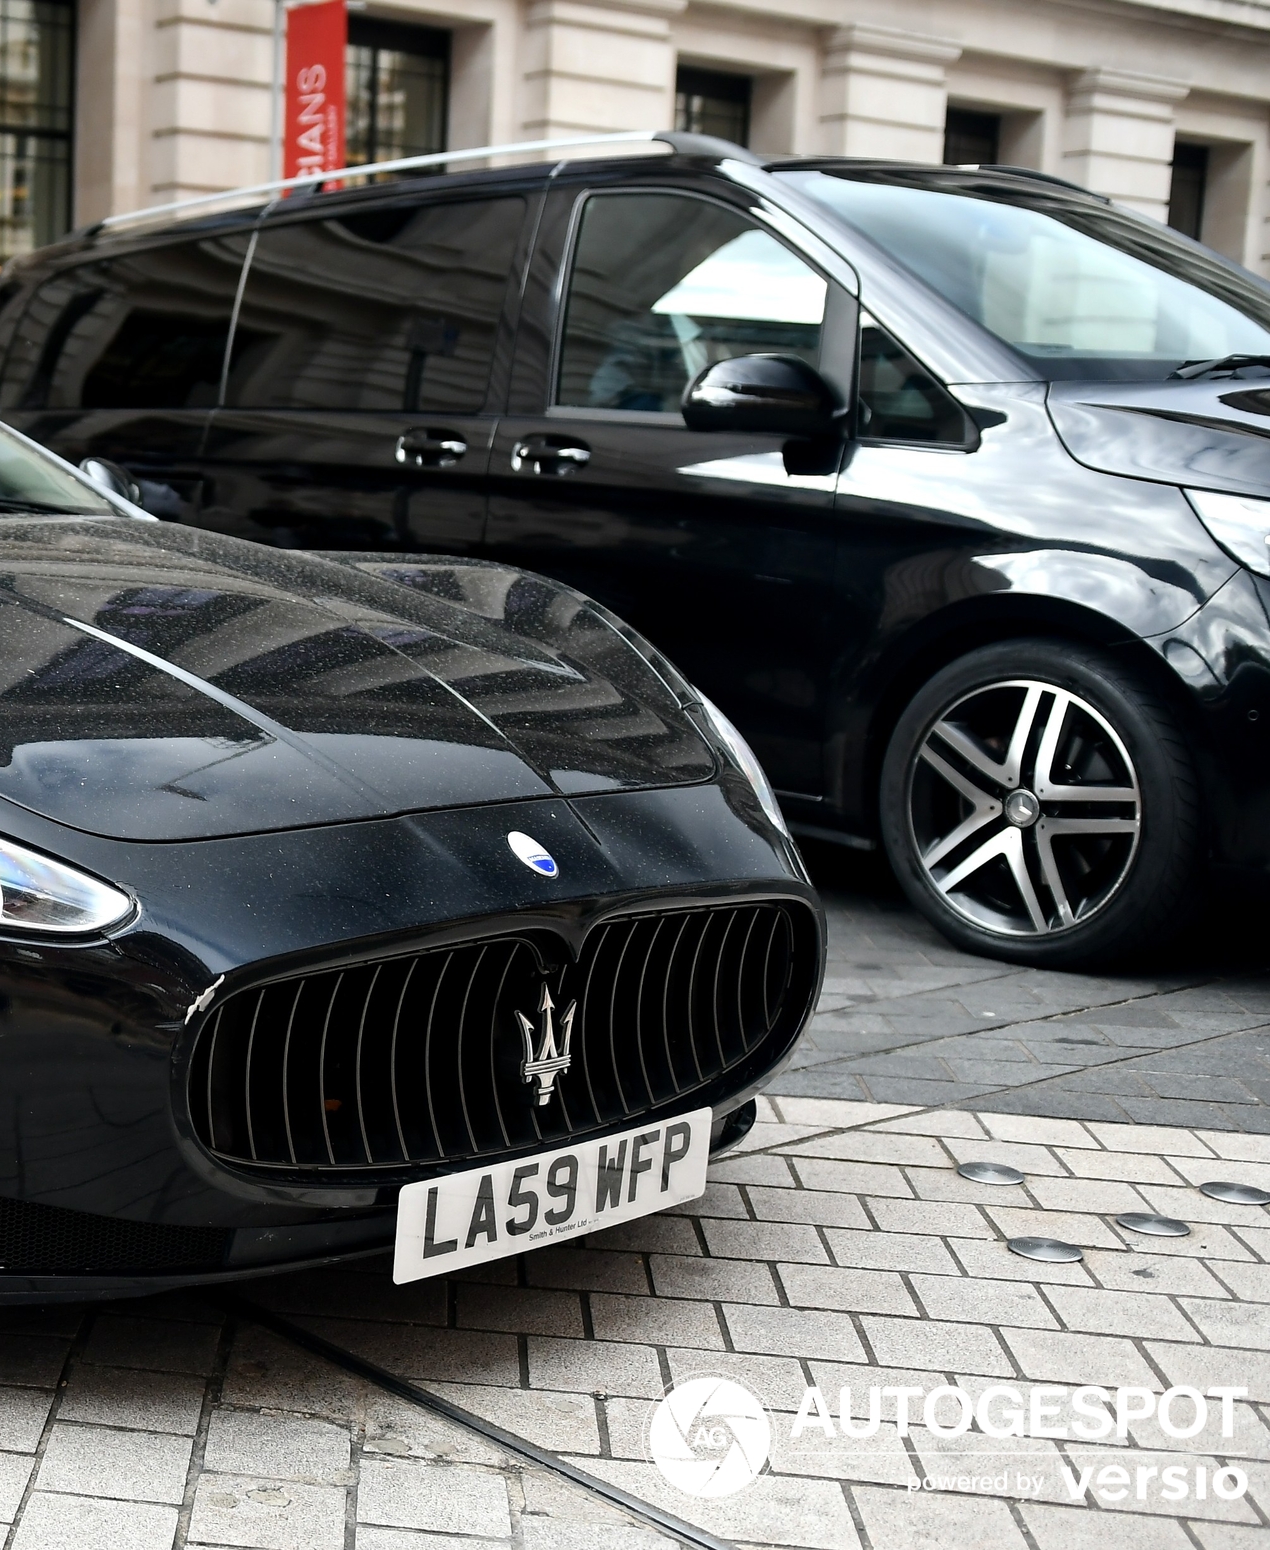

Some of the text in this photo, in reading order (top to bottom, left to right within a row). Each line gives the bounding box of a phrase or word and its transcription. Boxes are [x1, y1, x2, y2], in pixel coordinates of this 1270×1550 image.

[423, 1121, 691, 1259] LA59 WFP
[529, 1230, 548, 1241] Smith
[555, 1222, 577, 1234] Hunter
[577, 1218, 588, 1228] Ltd
